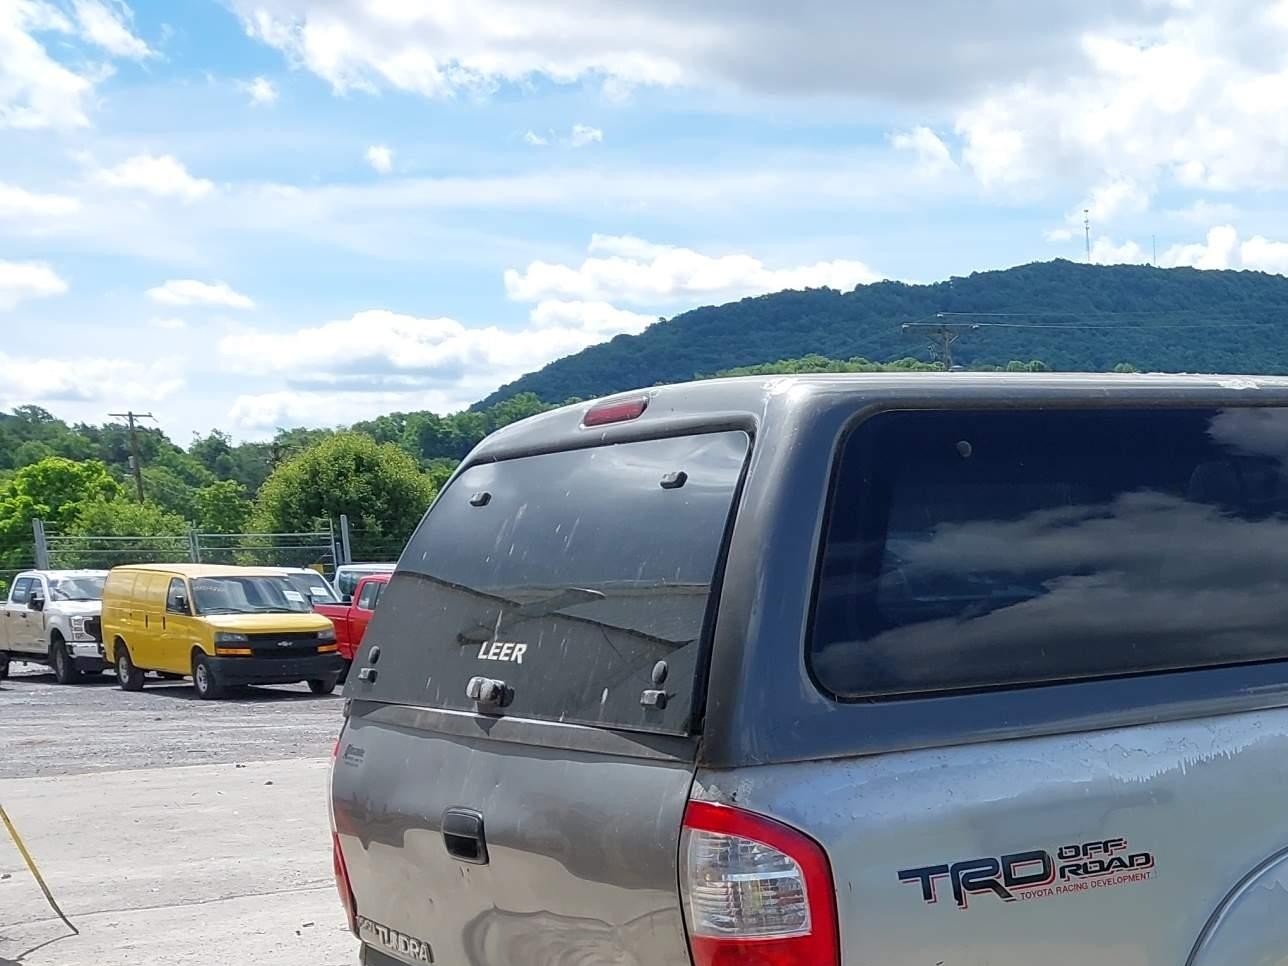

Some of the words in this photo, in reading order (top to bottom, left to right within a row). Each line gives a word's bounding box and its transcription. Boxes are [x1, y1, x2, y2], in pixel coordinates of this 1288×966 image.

[477, 641, 528, 664] LEER
[1057, 838, 1128, 863] OFF
[897, 849, 1057, 910] TRD
[1059, 852, 1155, 882] ROAD
[1020, 887, 1054, 901] TOYOTA
[1056, 881, 1089, 895] RACING
[1090, 872, 1152, 889] DEVELOPMENT
[376, 924, 436, 964] TUNDRA
